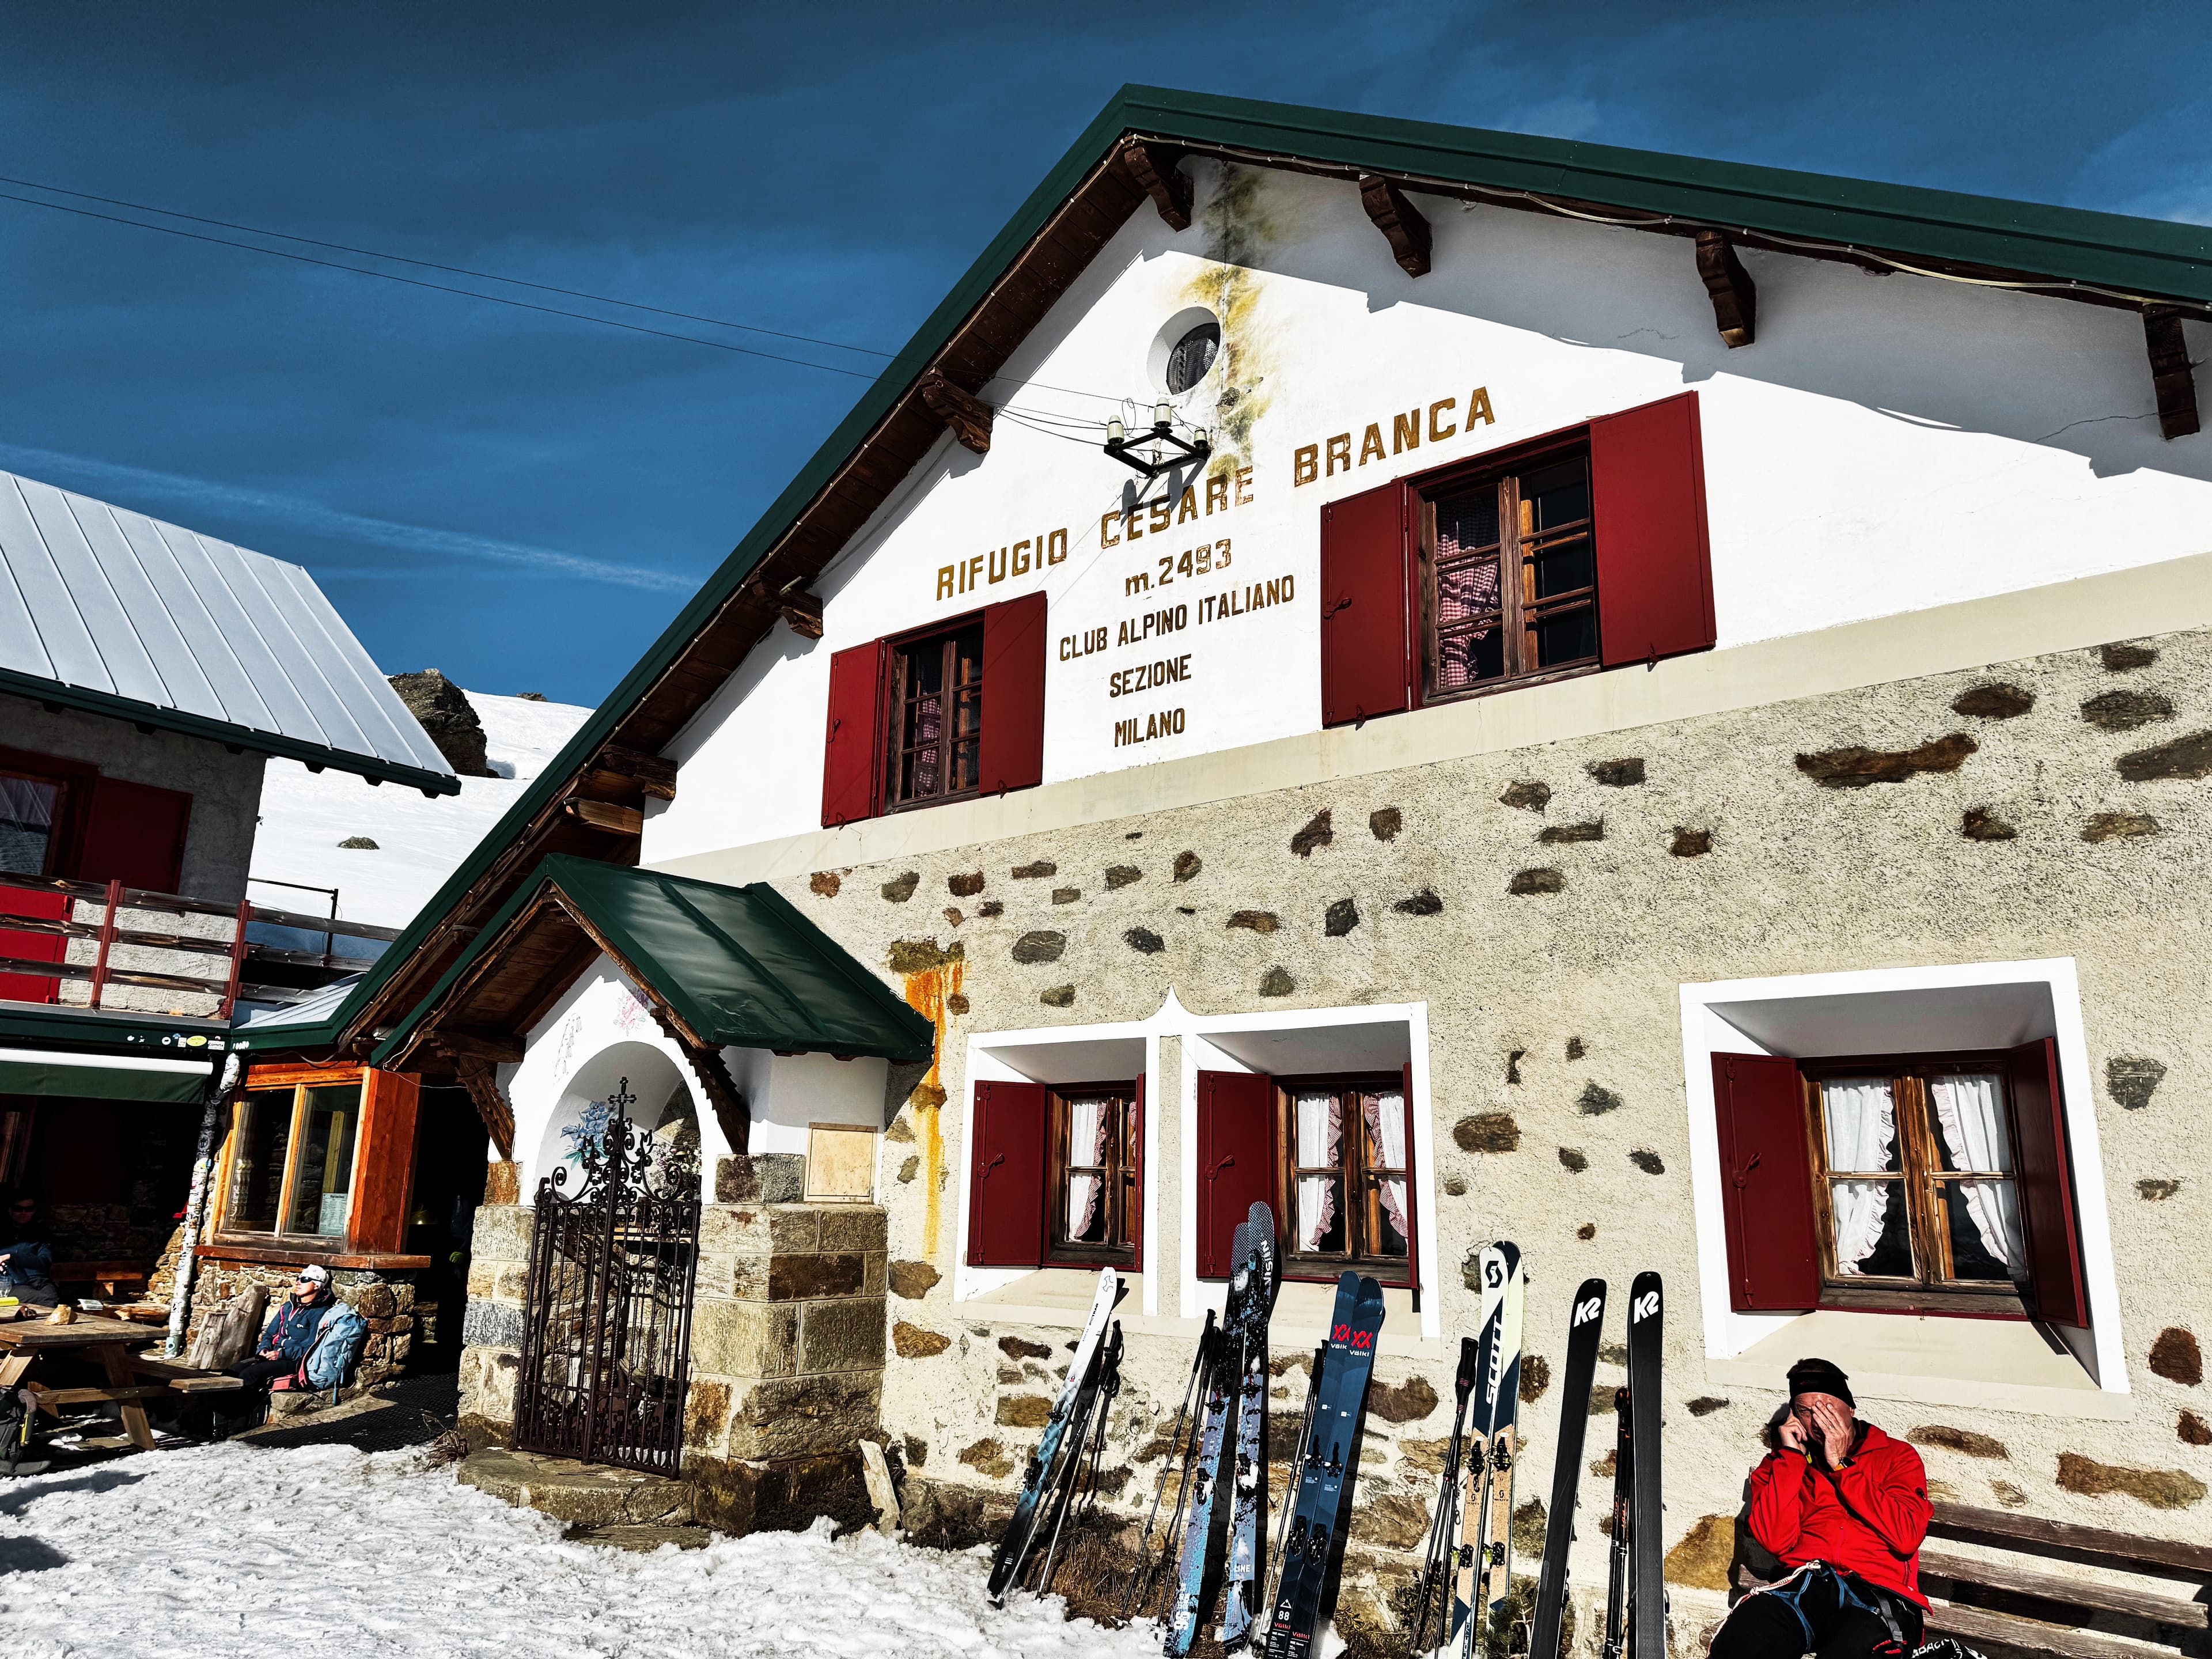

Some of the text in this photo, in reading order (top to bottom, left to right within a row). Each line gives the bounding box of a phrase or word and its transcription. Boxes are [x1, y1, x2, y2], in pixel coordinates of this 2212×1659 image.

[937, 386, 1495, 601] RIFUGIO CESARE BRANCA
[1059, 574, 1294, 661] CLUB ALPINO ITALIANO
[1109, 653, 1192, 698] SEZIONE
[1115, 707, 1185, 748] MILANO
[1574, 1297, 1601, 1328] K2
[1633, 1291, 1659, 1324] K2
[1486, 1315, 1503, 1404] SCOTT
[1234, 1565, 1251, 1573] LINE
[1278, 1610, 1290, 1621] 88
